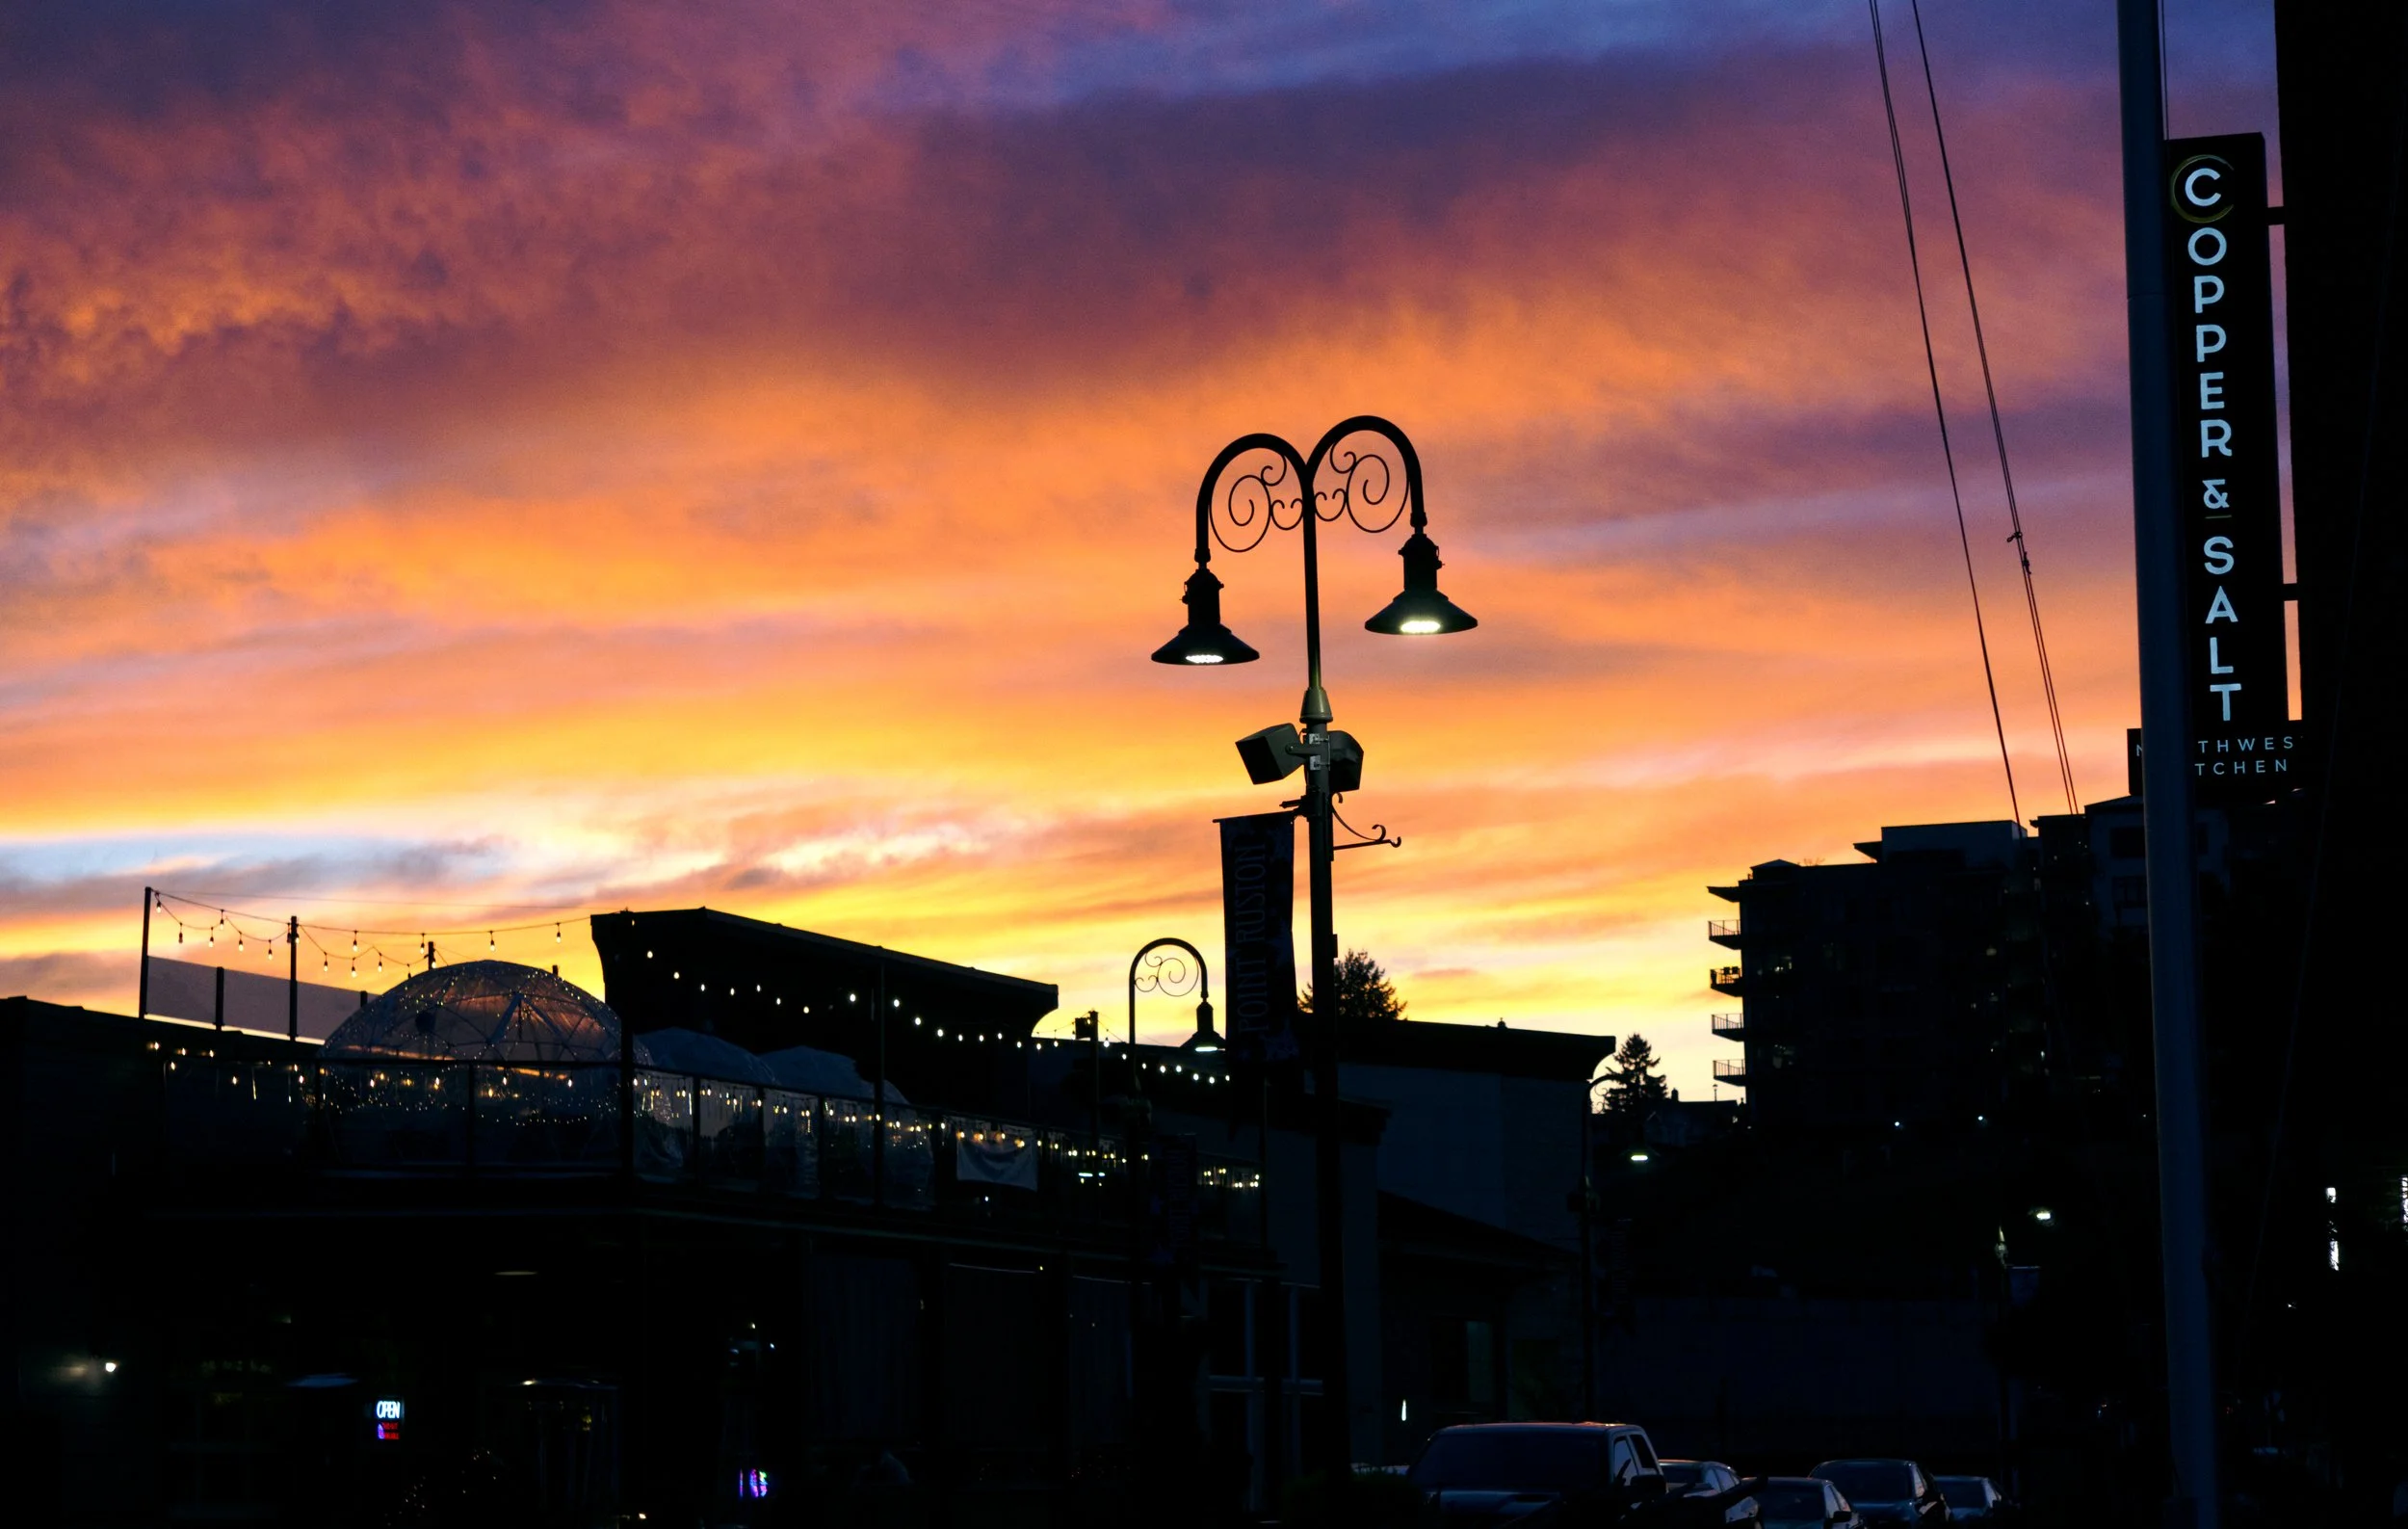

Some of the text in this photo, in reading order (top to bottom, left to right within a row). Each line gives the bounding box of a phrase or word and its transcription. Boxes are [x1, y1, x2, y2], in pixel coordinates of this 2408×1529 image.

[2185, 167, 2242, 722] COPPER & SALT
[2194, 758, 2288, 777] TCHEN
[1234, 842, 1270, 1036] POINT RUSTON
[377, 1400, 401, 1418] OPEN
